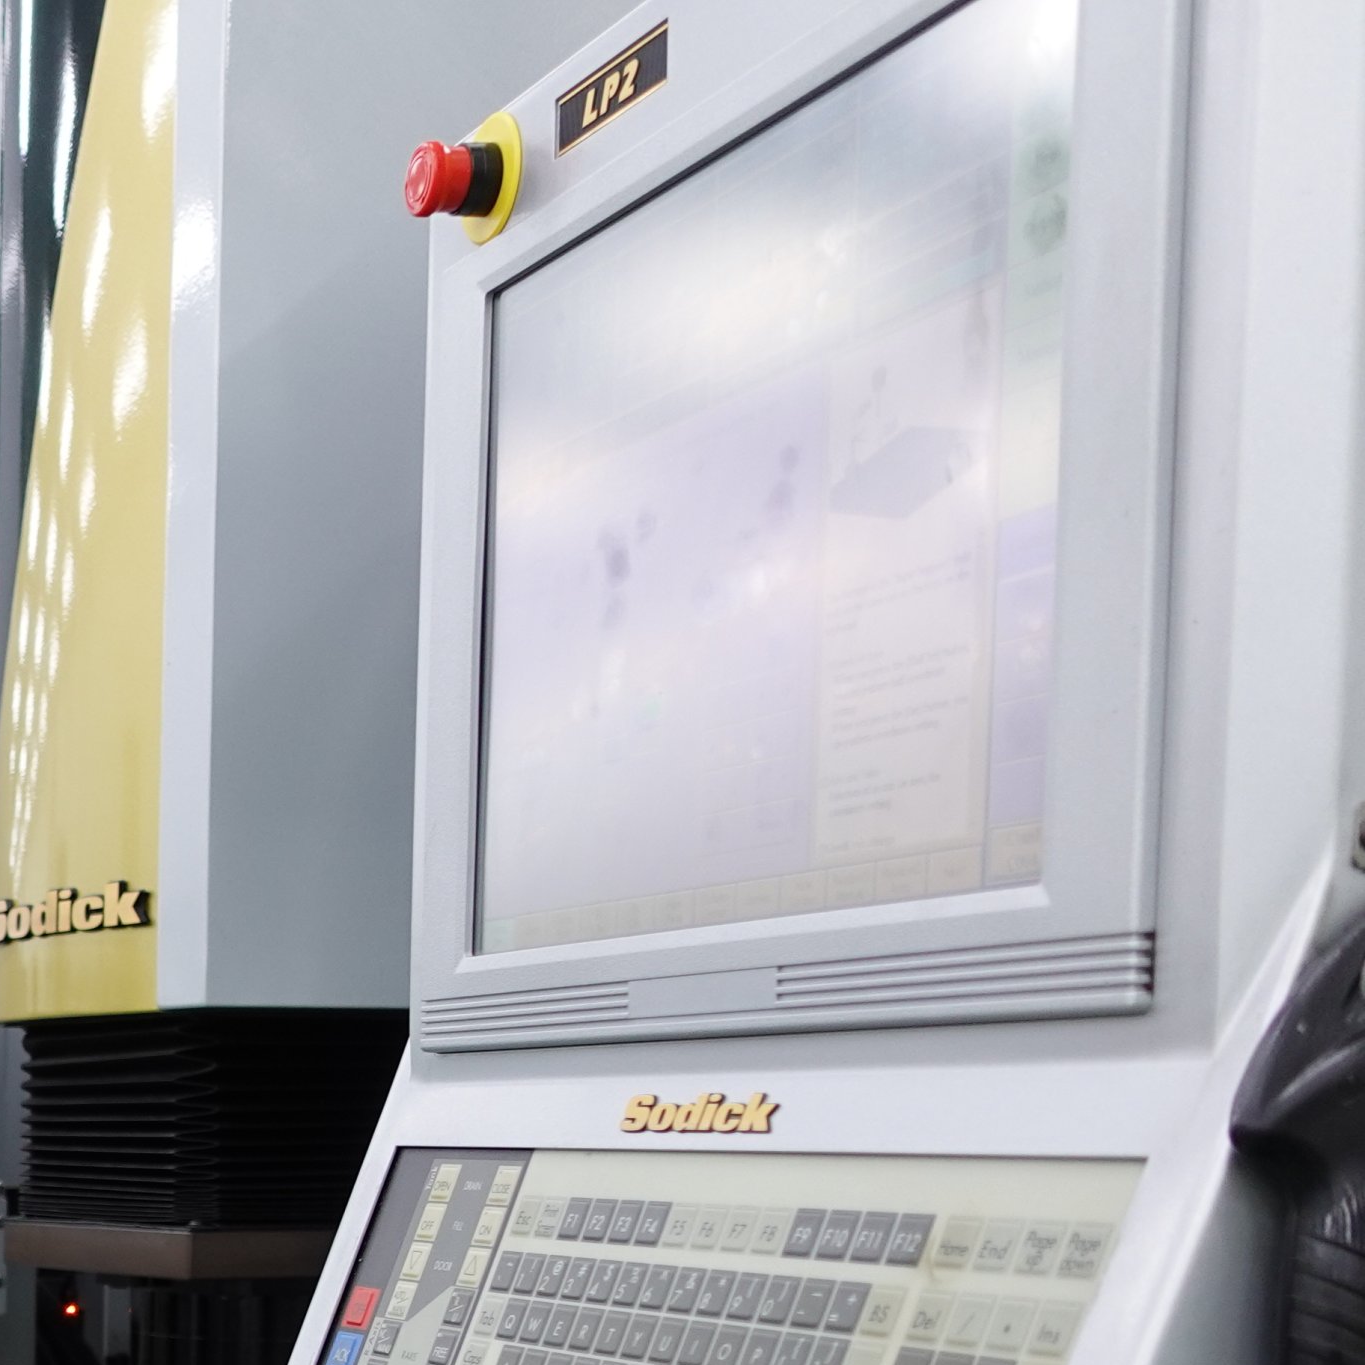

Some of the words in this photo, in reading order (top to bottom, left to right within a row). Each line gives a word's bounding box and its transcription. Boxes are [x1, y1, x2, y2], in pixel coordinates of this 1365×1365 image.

[621, 1092, 780, 1134] Sodick
[434, 1180, 452, 1192] OPEN
[491, 1184, 511, 1194] CLOSE
[515, 1210, 532, 1225] Esc
[564, 1213, 580, 1228] F1
[588, 1215, 606, 1230] F2
[615, 1217, 632, 1232] F3
[478, 1225, 492, 1235] ON
[641, 1218, 659, 1233] F4
[671, 1219, 688, 1236] F5
[699, 1222, 715, 1237] F6
[727, 1224, 747, 1238] F7
[759, 1225, 778, 1242] F8
[791, 1227, 812, 1244] F9
[823, 1230, 849, 1248] F10
[856, 1231, 883, 1249] F11
[1026, 1231, 1057, 1250] Page
[891, 1233, 922, 1252] F12
[978, 1240, 1013, 1259] End
[1070, 1232, 1102, 1256] Page
[538, 1276, 550, 1291] 2
[563, 1278, 574, 1293] 3
[588, 1282, 600, 1296] 4
[615, 1284, 627, 1298] 5
[642, 1288, 653, 1302] 6
[670, 1290, 683, 1304] 7
[699, 1292, 712, 1309] 8
[730, 1295, 743, 1312] 9
[481, 1311, 495, 1326] Tab
[505, 1315, 516, 1330] Q
[527, 1318, 541, 1332] W
[912, 1309, 943, 1330] Del
[553, 1321, 564, 1336] E
[577, 1325, 589, 1340] R
[605, 1328, 616, 1343] T
[632, 1332, 643, 1347] Y
[659, 1336, 672, 1352] U
[432, 1346, 449, 1358] FREE
[689, 1340, 699, 1355] I
[717, 1343, 732, 1360] O
[749, 1347, 763, 1364] P
